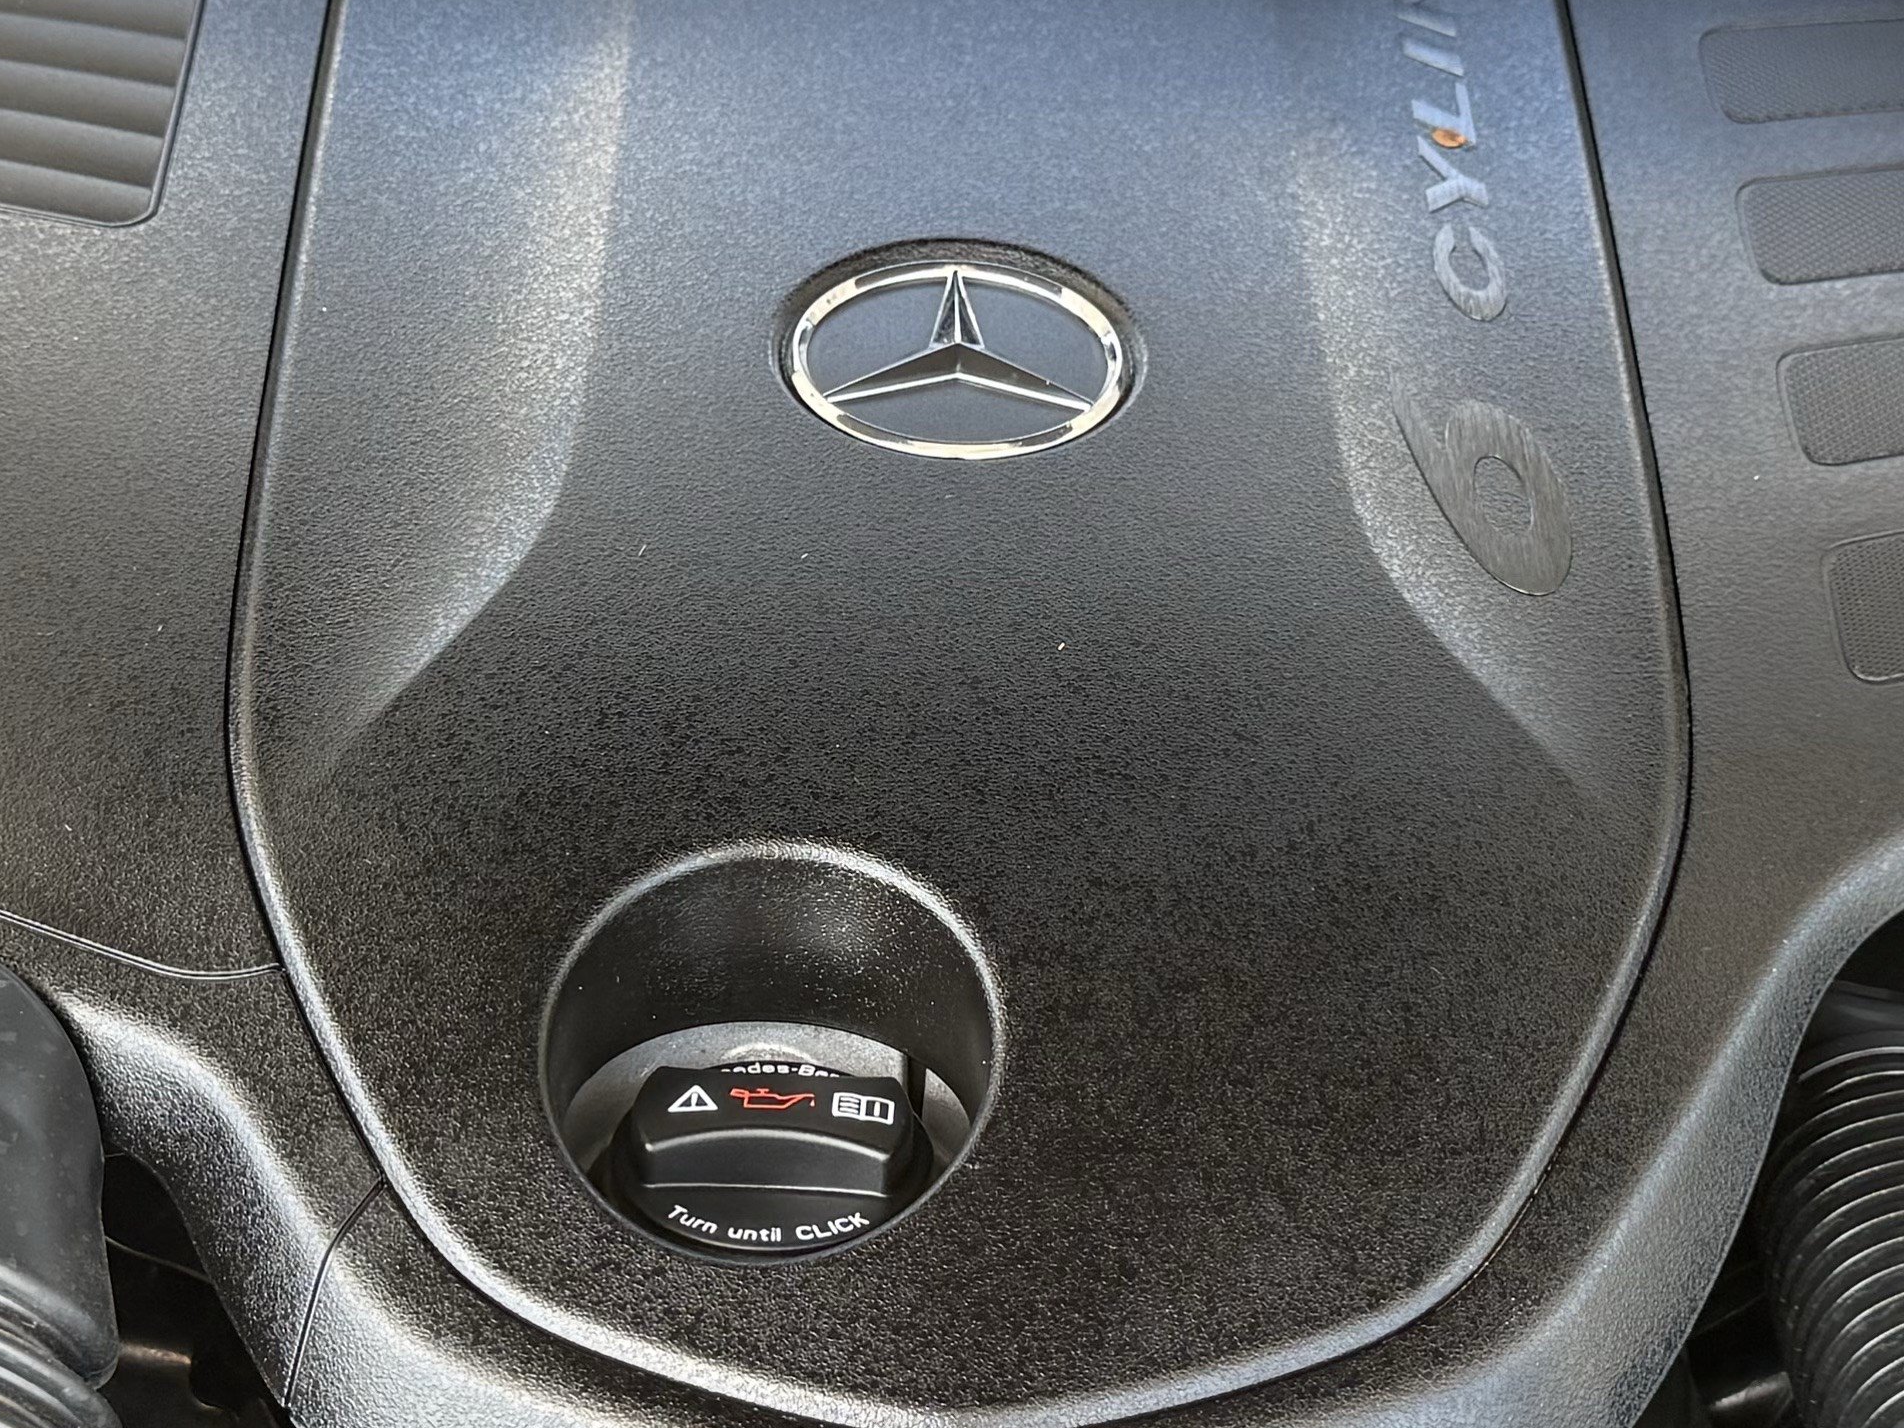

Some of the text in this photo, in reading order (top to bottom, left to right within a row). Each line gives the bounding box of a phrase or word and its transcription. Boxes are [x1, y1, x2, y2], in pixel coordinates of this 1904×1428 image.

[1390, 369, 1573, 596] 6
[667, 1204, 871, 1243] Turn until CLICK
